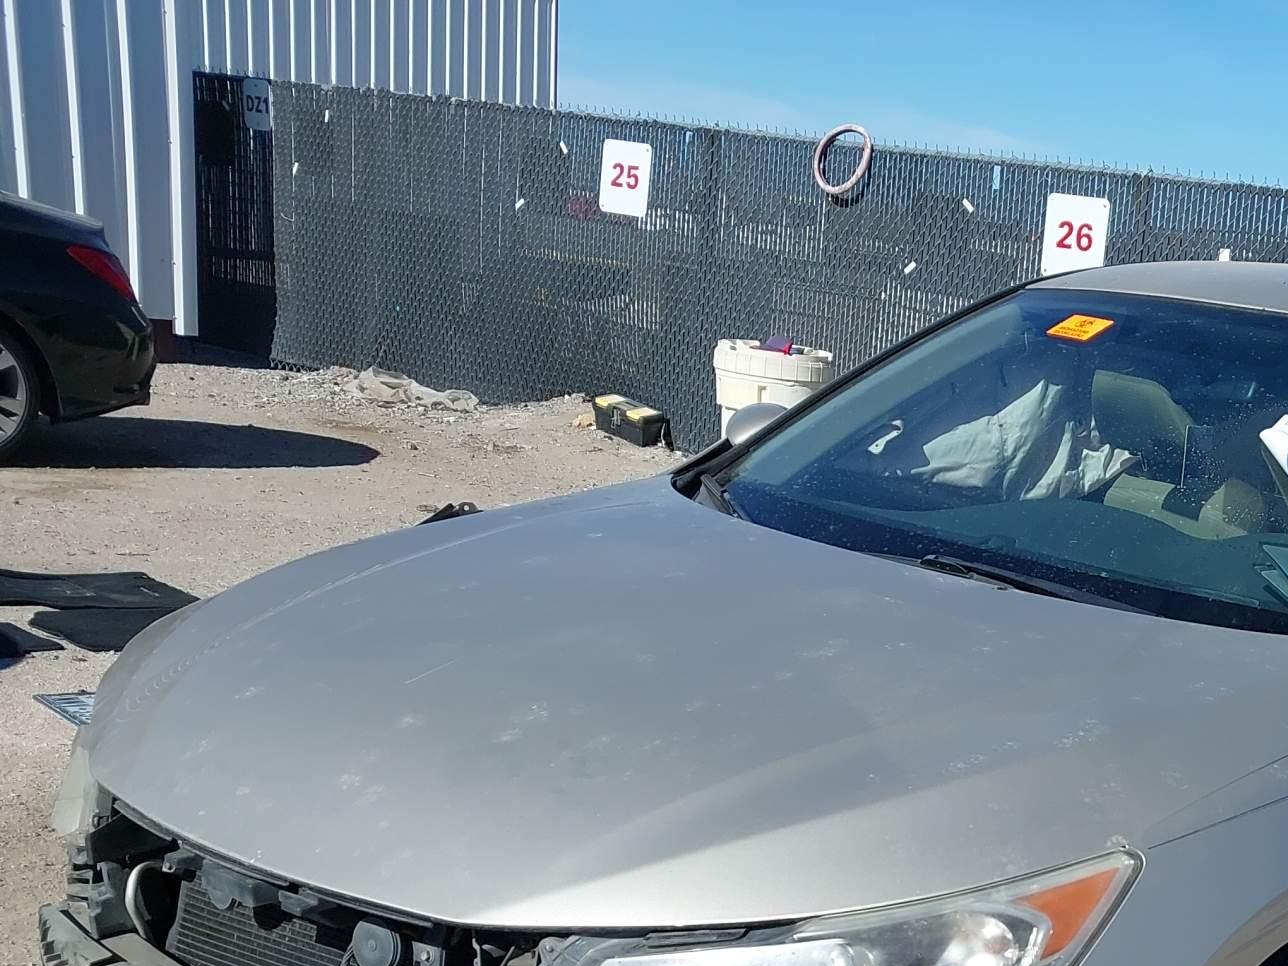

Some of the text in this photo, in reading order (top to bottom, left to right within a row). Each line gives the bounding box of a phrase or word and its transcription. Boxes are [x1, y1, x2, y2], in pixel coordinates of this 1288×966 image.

[246, 94, 269, 114] DZ1
[610, 162, 640, 190] 25
[1055, 220, 1093, 252] 26
